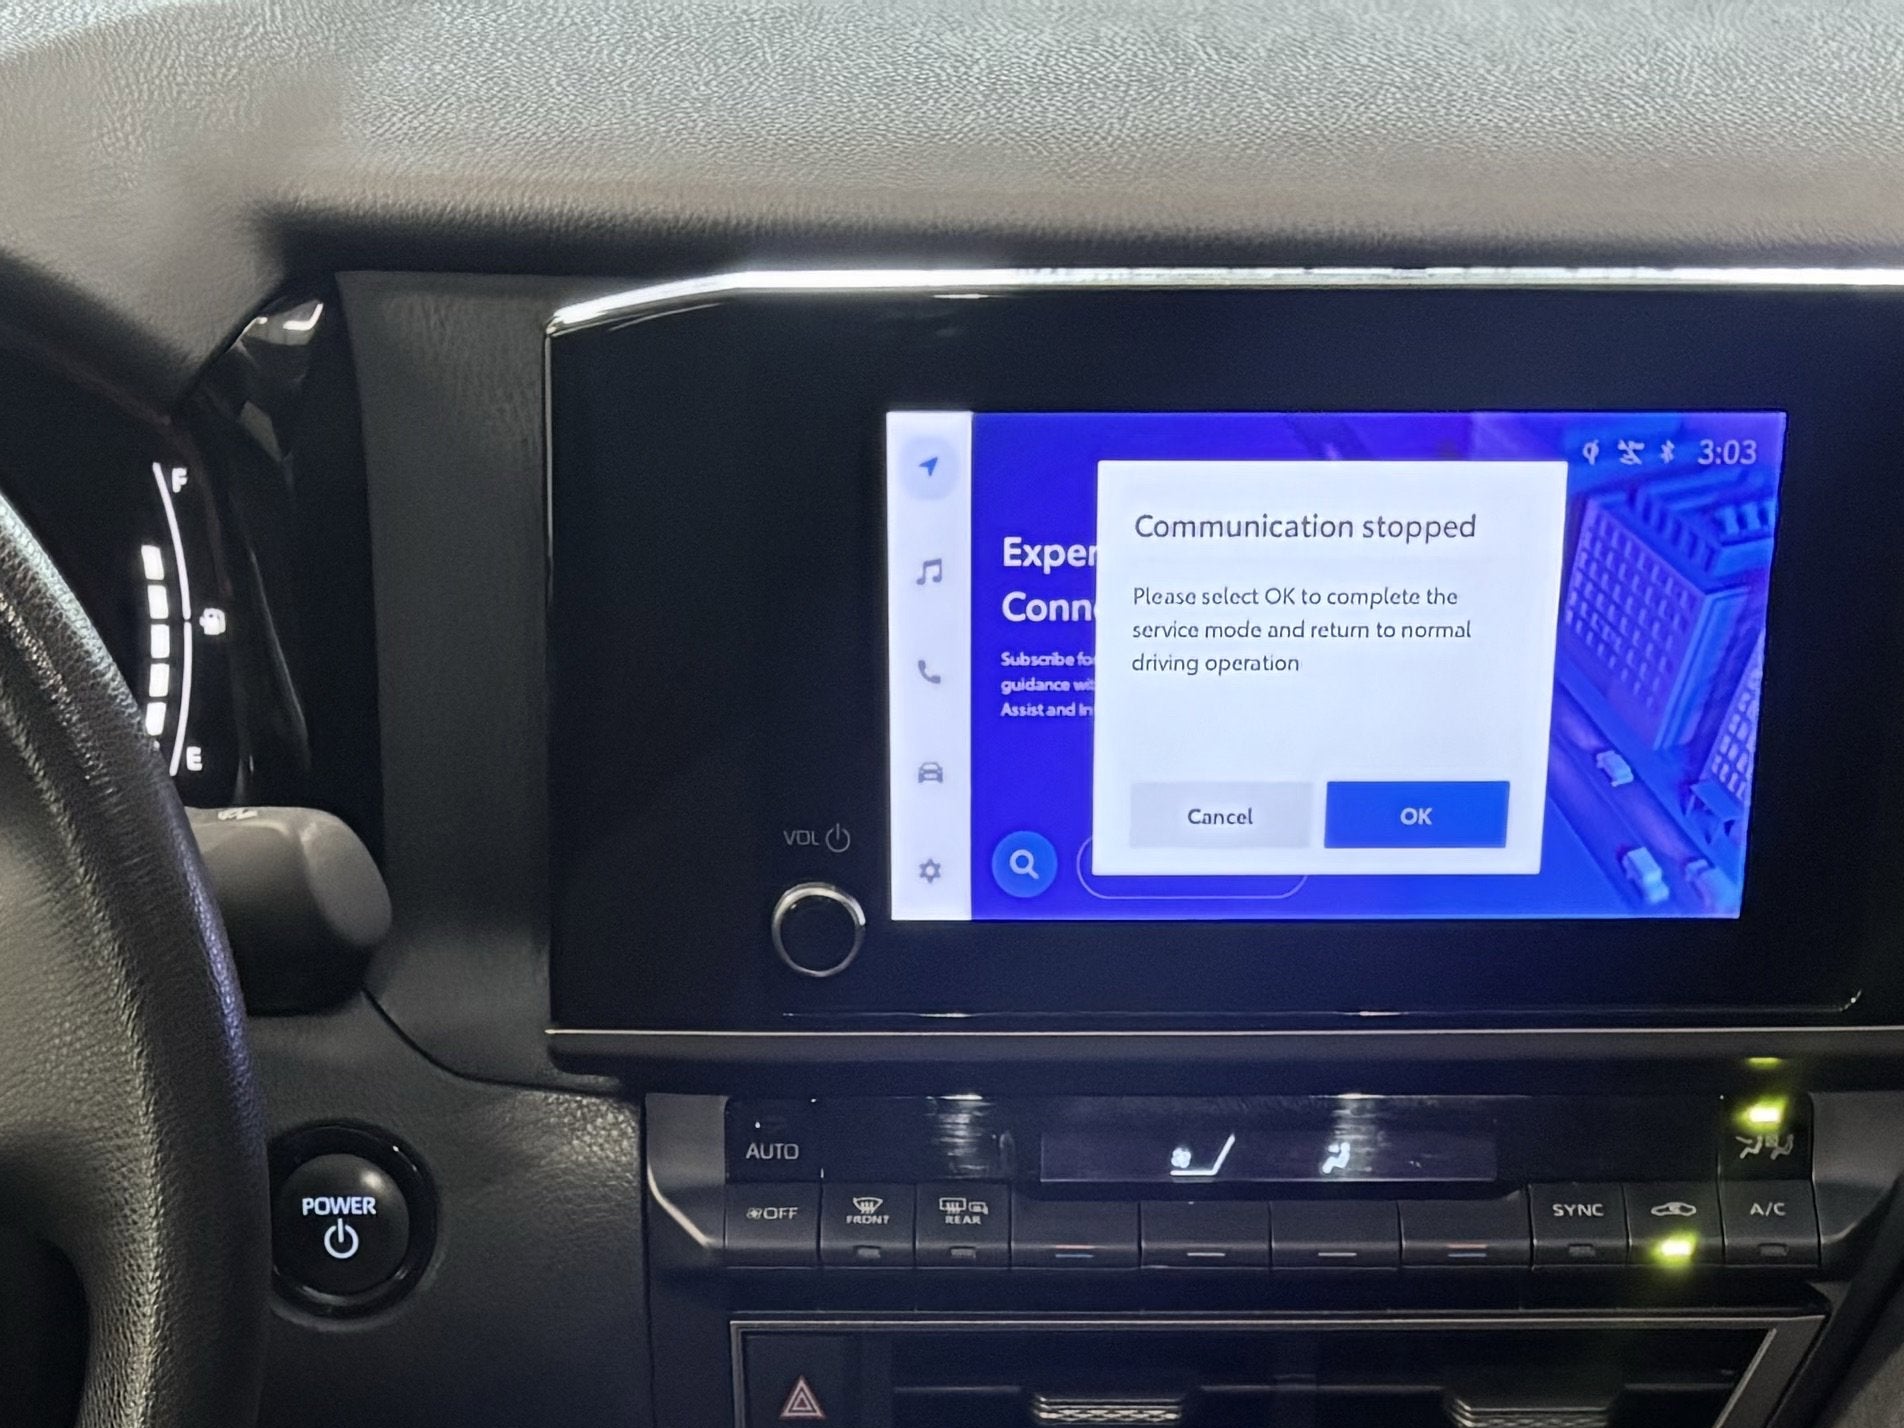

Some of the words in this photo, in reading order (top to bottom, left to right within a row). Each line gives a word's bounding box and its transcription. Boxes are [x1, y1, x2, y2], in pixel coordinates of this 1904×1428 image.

[1697, 439, 1758, 466] 3:03
[171, 467, 188, 492] F
[1134, 512, 1354, 539] Communication
[1362, 512, 1477, 544] stopped
[1001, 591, 1096, 623] Conn
[1133, 586, 1197, 606] Please
[1201, 586, 1259, 606] select
[1265, 587, 1296, 606] OK
[1301, 589, 1322, 606] to
[1327, 586, 1420, 610] complete
[1427, 586, 1458, 606] the
[1132, 620, 1200, 639] service
[1205, 620, 1262, 639] mode
[1267, 620, 1305, 639] and
[1310, 623, 1369, 639] return
[1376, 622, 1395, 639] to
[1401, 620, 1472, 639] normal
[1000, 651, 1075, 667] Subscribe
[1131, 653, 1199, 676] driving
[1204, 653, 1300, 676] operation
[1000, 677, 1071, 696] guidance
[1000, 702, 1045, 717] Assist
[1046, 702, 1076, 717] and
[185, 746, 202, 770] E
[1187, 805, 1253, 826] Cancel
[1399, 805, 1433, 826] OK
[783, 830, 820, 846] VOL
[746, 1142, 799, 1161] AUTO
[302, 1197, 377, 1216] POWER
[763, 1206, 799, 1221] OFF
[1551, 1203, 1605, 1218] SYNC
[1749, 1202, 1787, 1218] A/C
[846, 1215, 890, 1225] FRONT
[944, 1214, 982, 1225] REAR
